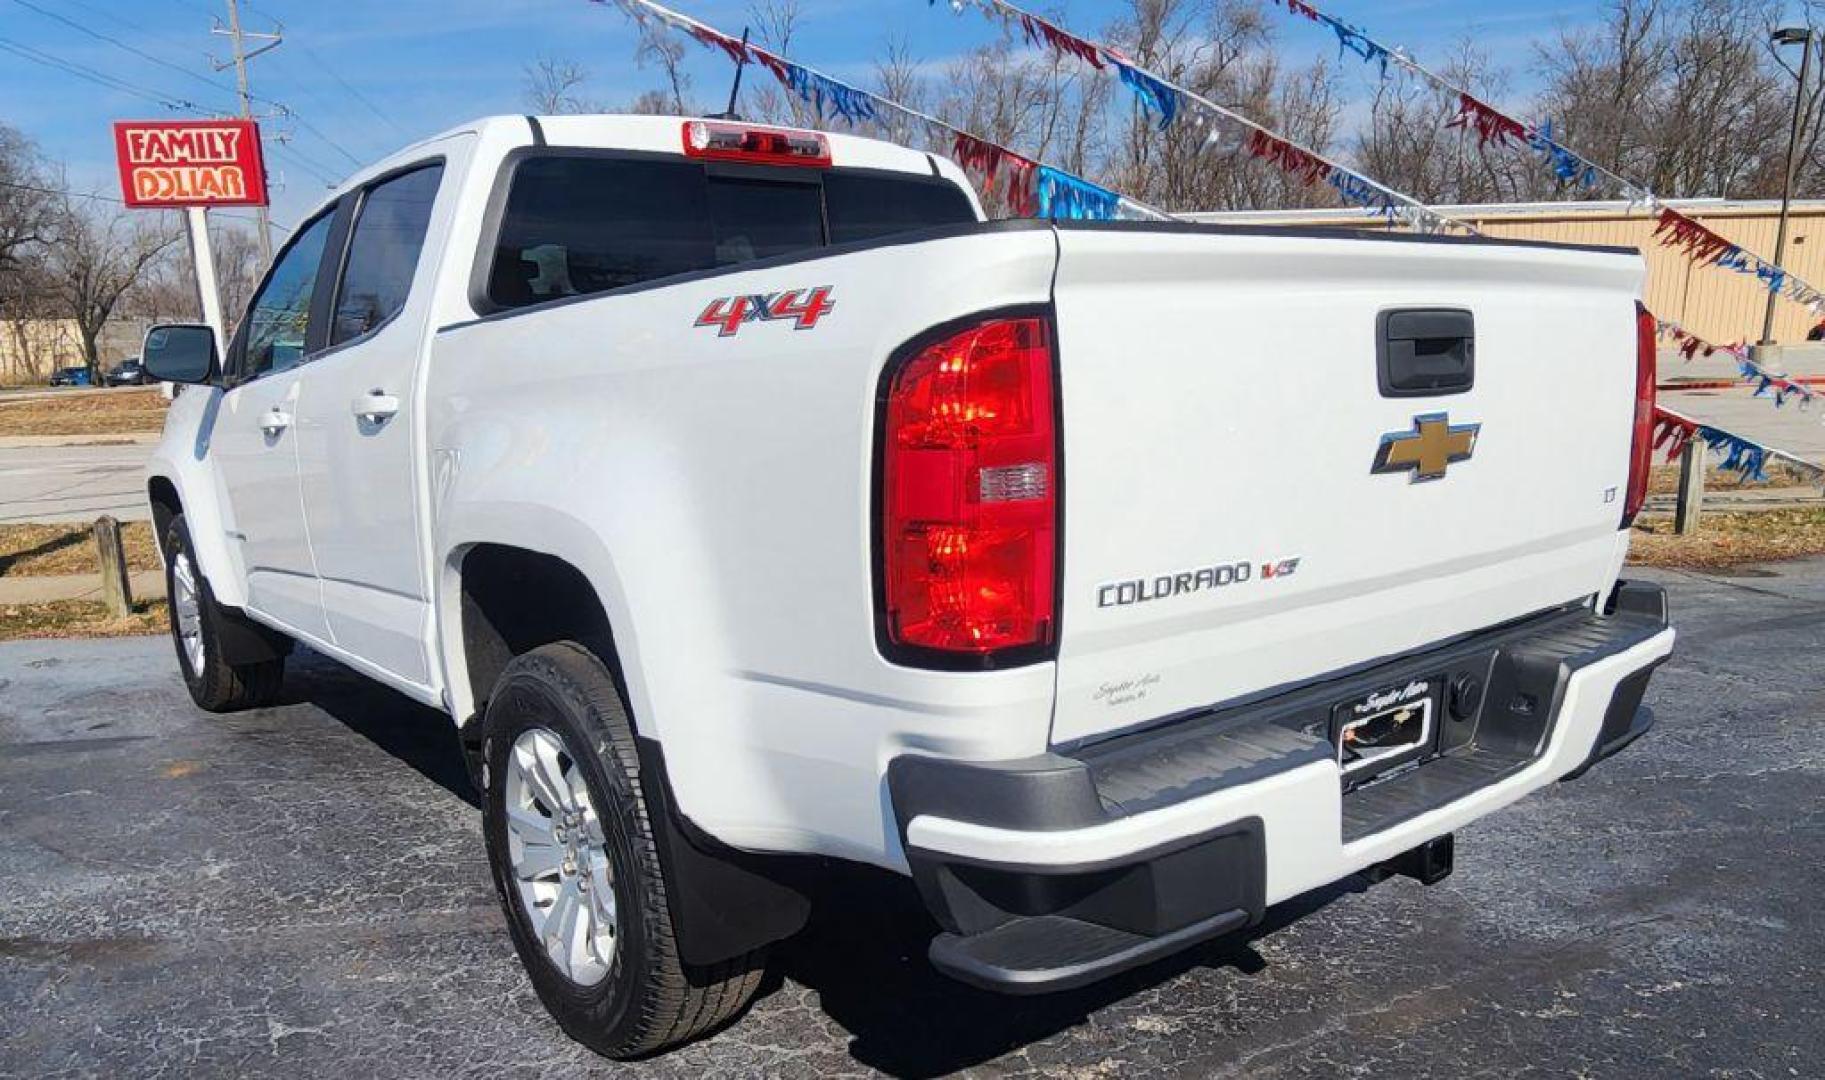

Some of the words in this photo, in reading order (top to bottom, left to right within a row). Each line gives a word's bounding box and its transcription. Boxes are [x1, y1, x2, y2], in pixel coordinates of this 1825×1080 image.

[126, 128, 241, 162] FAMILY
[133, 166, 246, 200] DOLLAR
[1097, 562, 1252, 608] COLORADO
